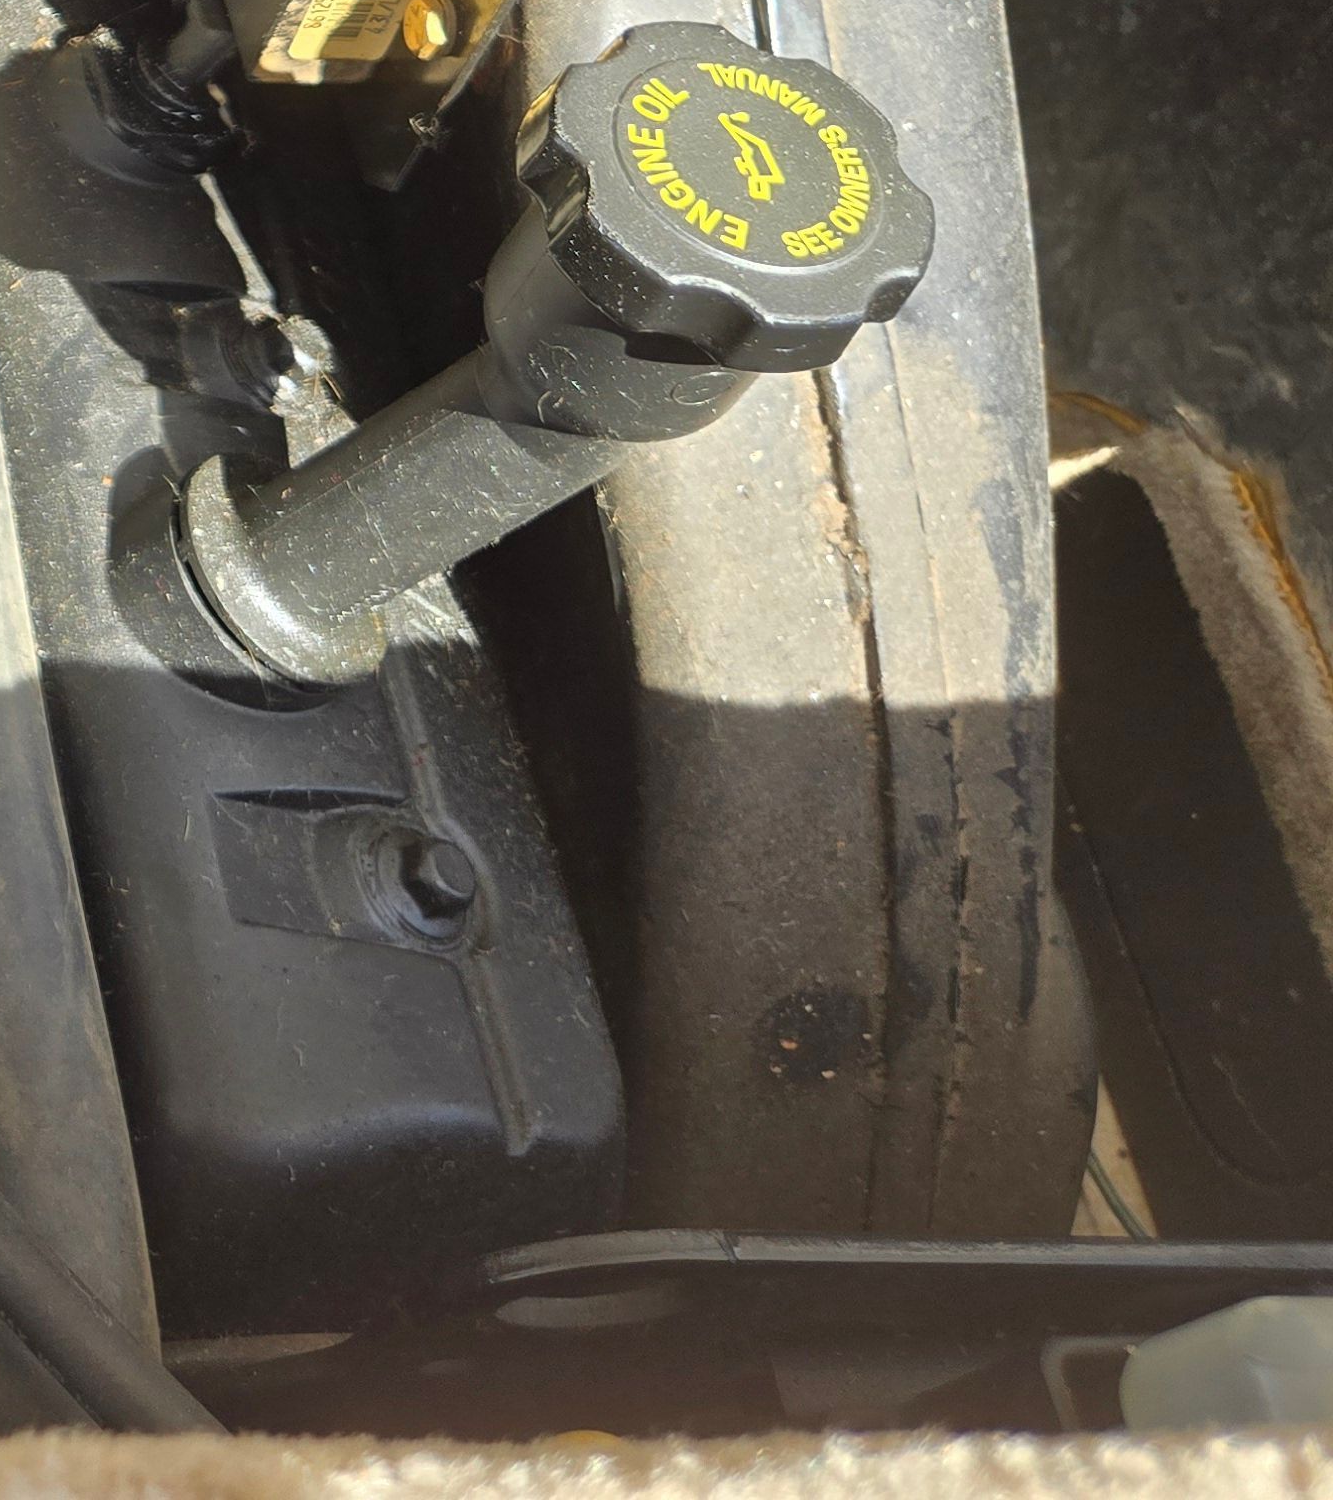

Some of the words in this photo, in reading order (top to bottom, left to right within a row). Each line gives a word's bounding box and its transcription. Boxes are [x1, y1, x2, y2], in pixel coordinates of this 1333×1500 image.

[632, 77, 690, 122] OIL
[696, 62, 826, 127] MANUAL
[627, 123, 749, 250] ENGINE
[818, 124, 870, 234] OWNER'S
[781, 221, 843, 257] SEE
